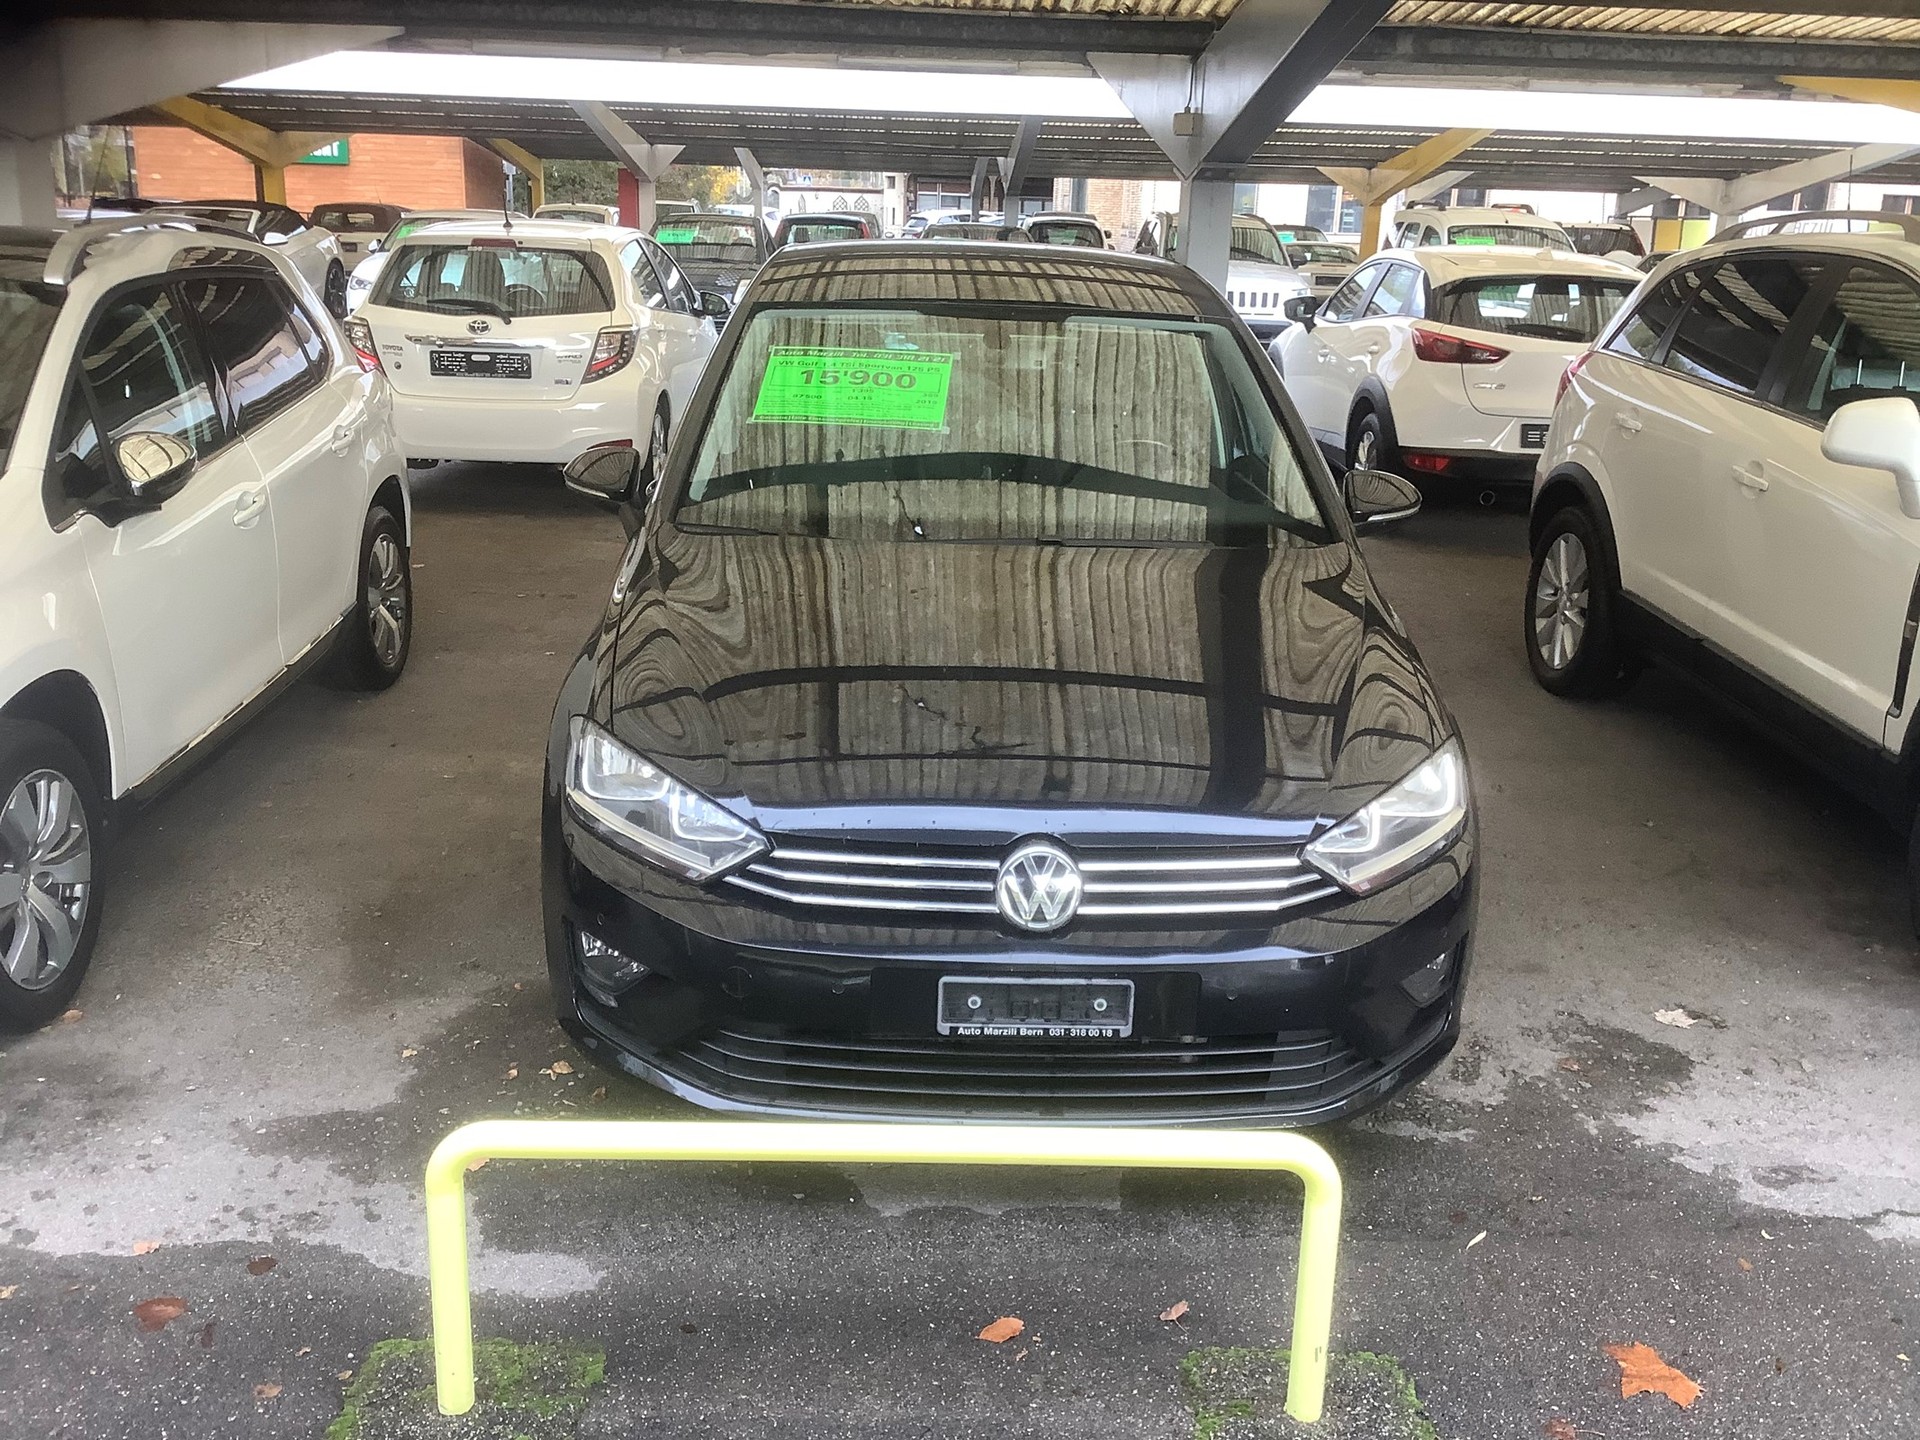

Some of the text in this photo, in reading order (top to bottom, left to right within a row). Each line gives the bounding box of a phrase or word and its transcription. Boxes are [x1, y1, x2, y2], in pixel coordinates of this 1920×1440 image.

[382, 344, 404, 352] TOYOTA
[777, 349, 804, 357] Auto
[857, 362, 903, 371] Sportvan
[800, 369, 917, 389] 15'900
[957, 1026, 981, 1036] Auto
[983, 1026, 1017, 1036] Marzili
[1019, 1027, 1044, 1037] Bern
[1088, 1028, 1100, 1038] 00
[1101, 1029, 1113, 1038] 18
